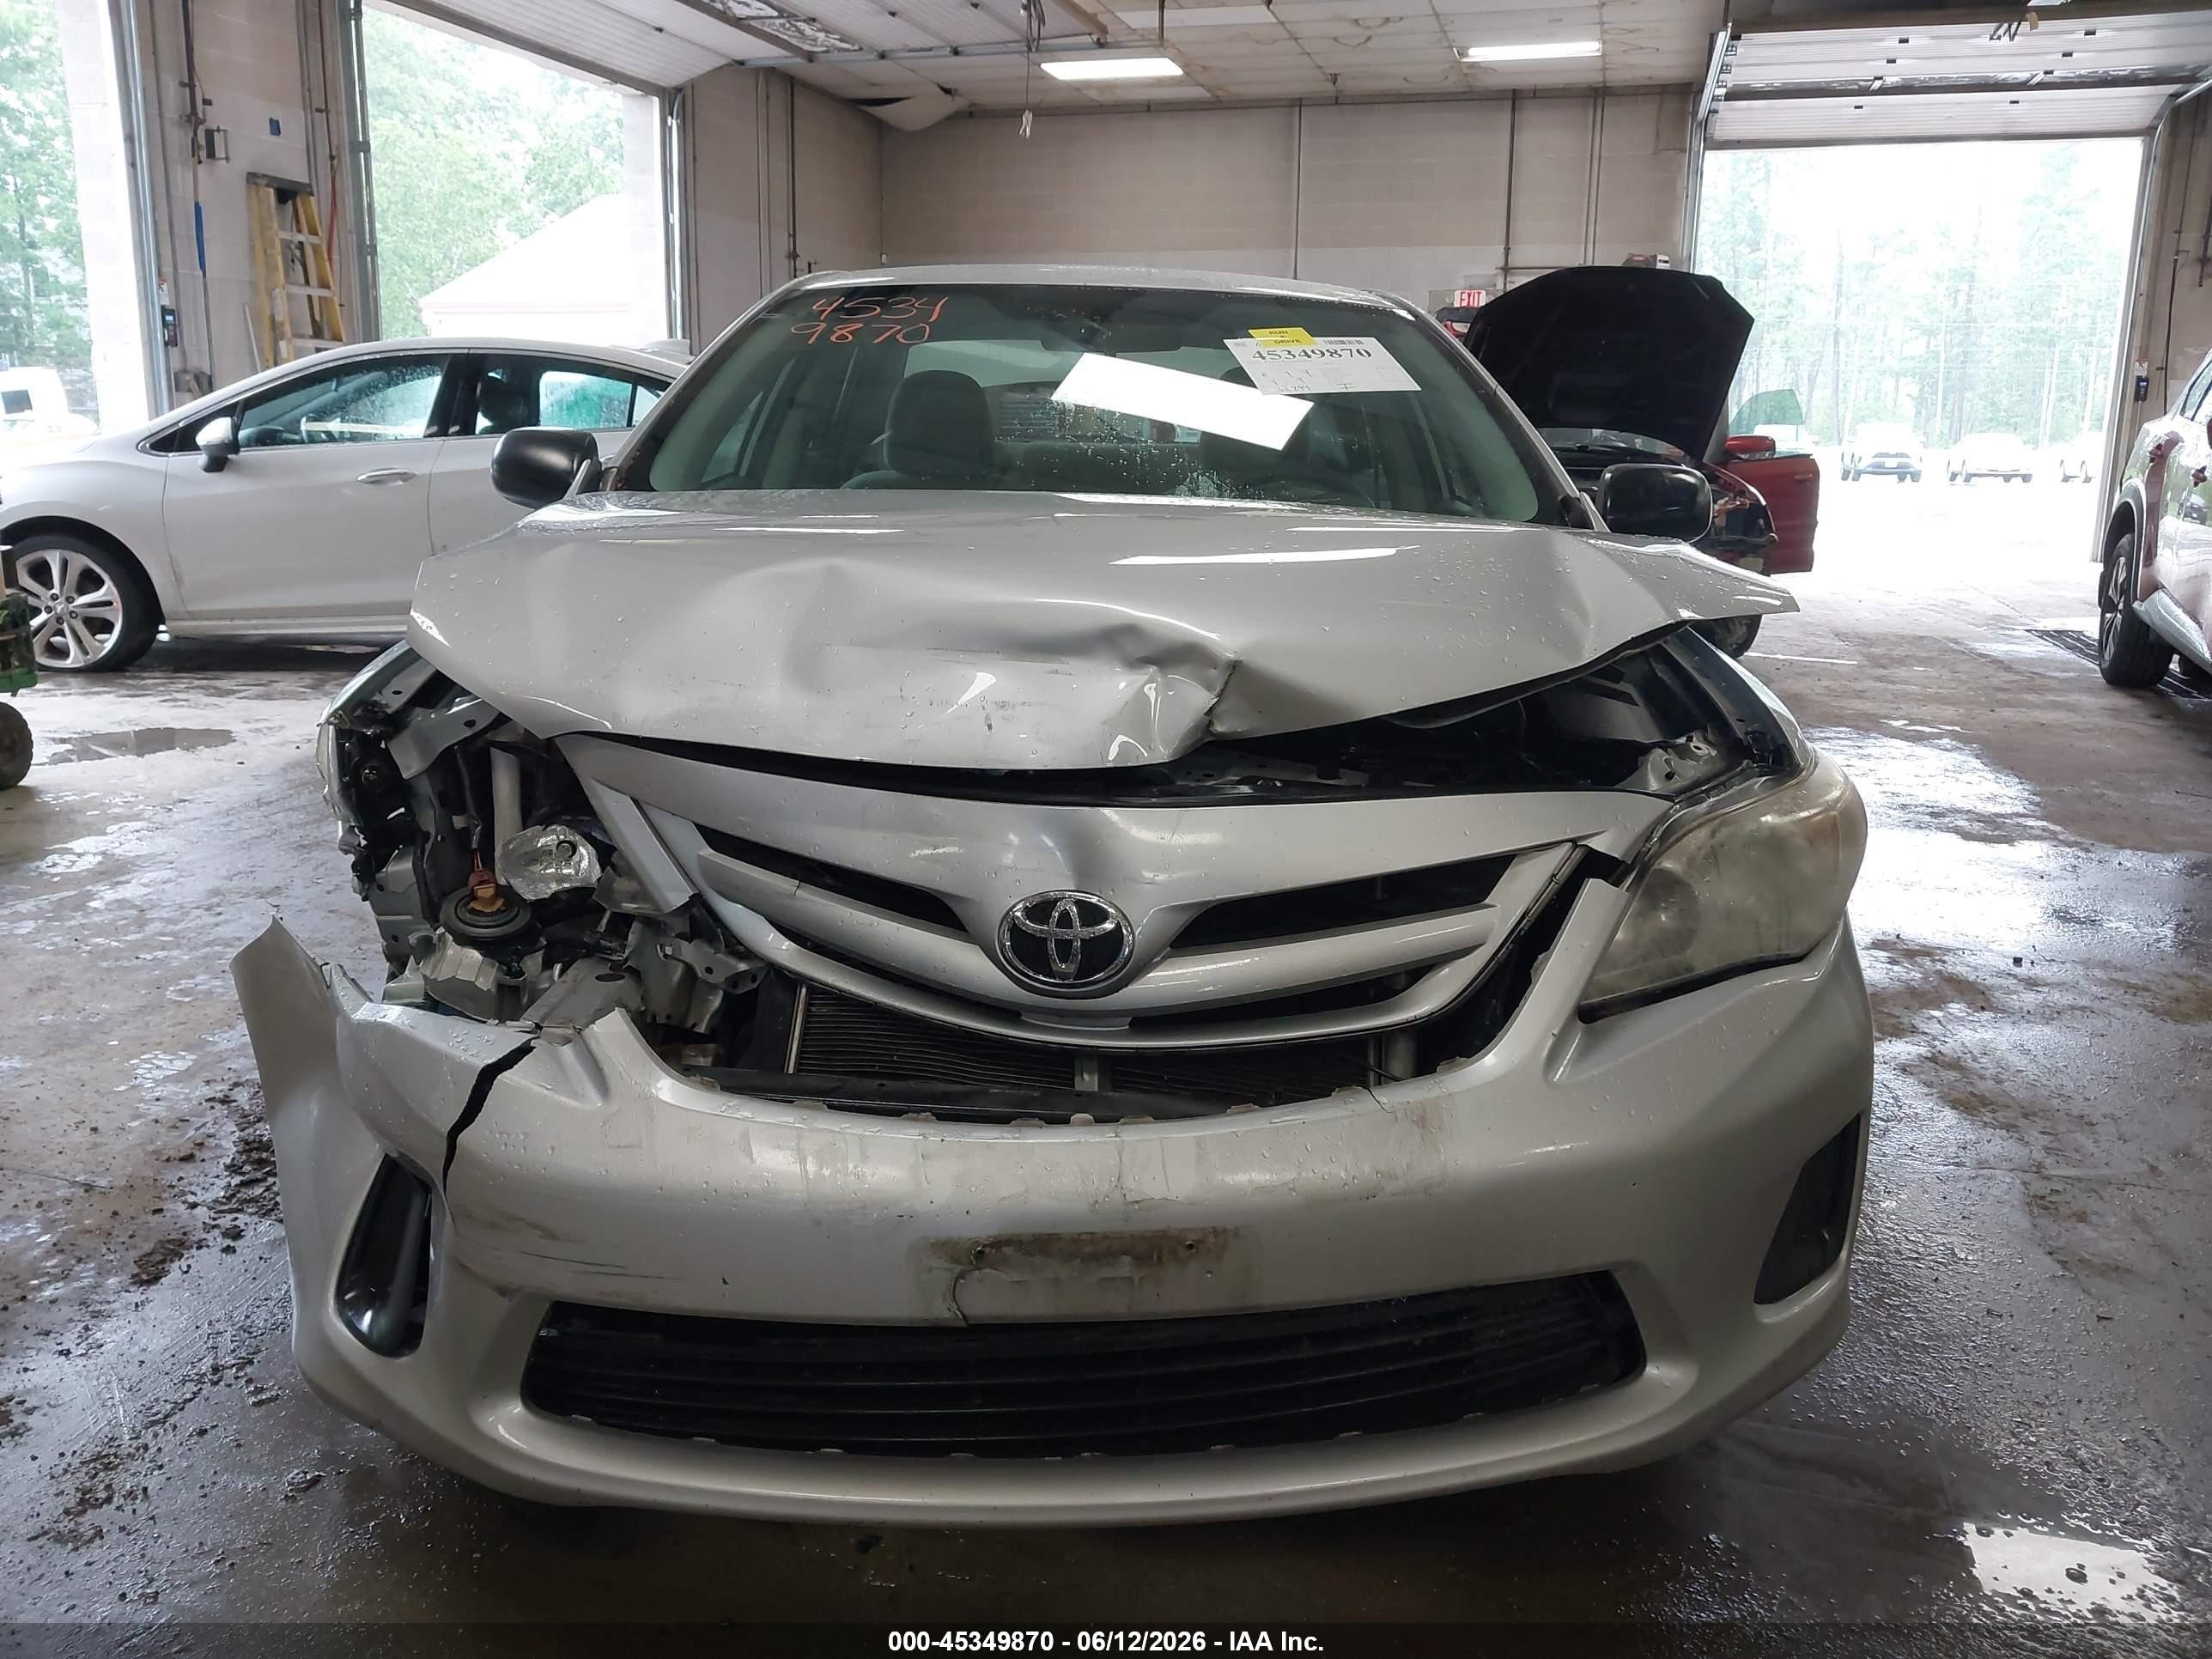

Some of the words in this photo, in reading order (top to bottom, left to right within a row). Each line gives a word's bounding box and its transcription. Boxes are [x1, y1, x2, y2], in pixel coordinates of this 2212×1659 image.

[1460, 291, 1482, 307] EXIT
[811, 296, 949, 323] 4534
[790, 322, 930, 344] 9870
[1252, 348, 1372, 360] 45349870
